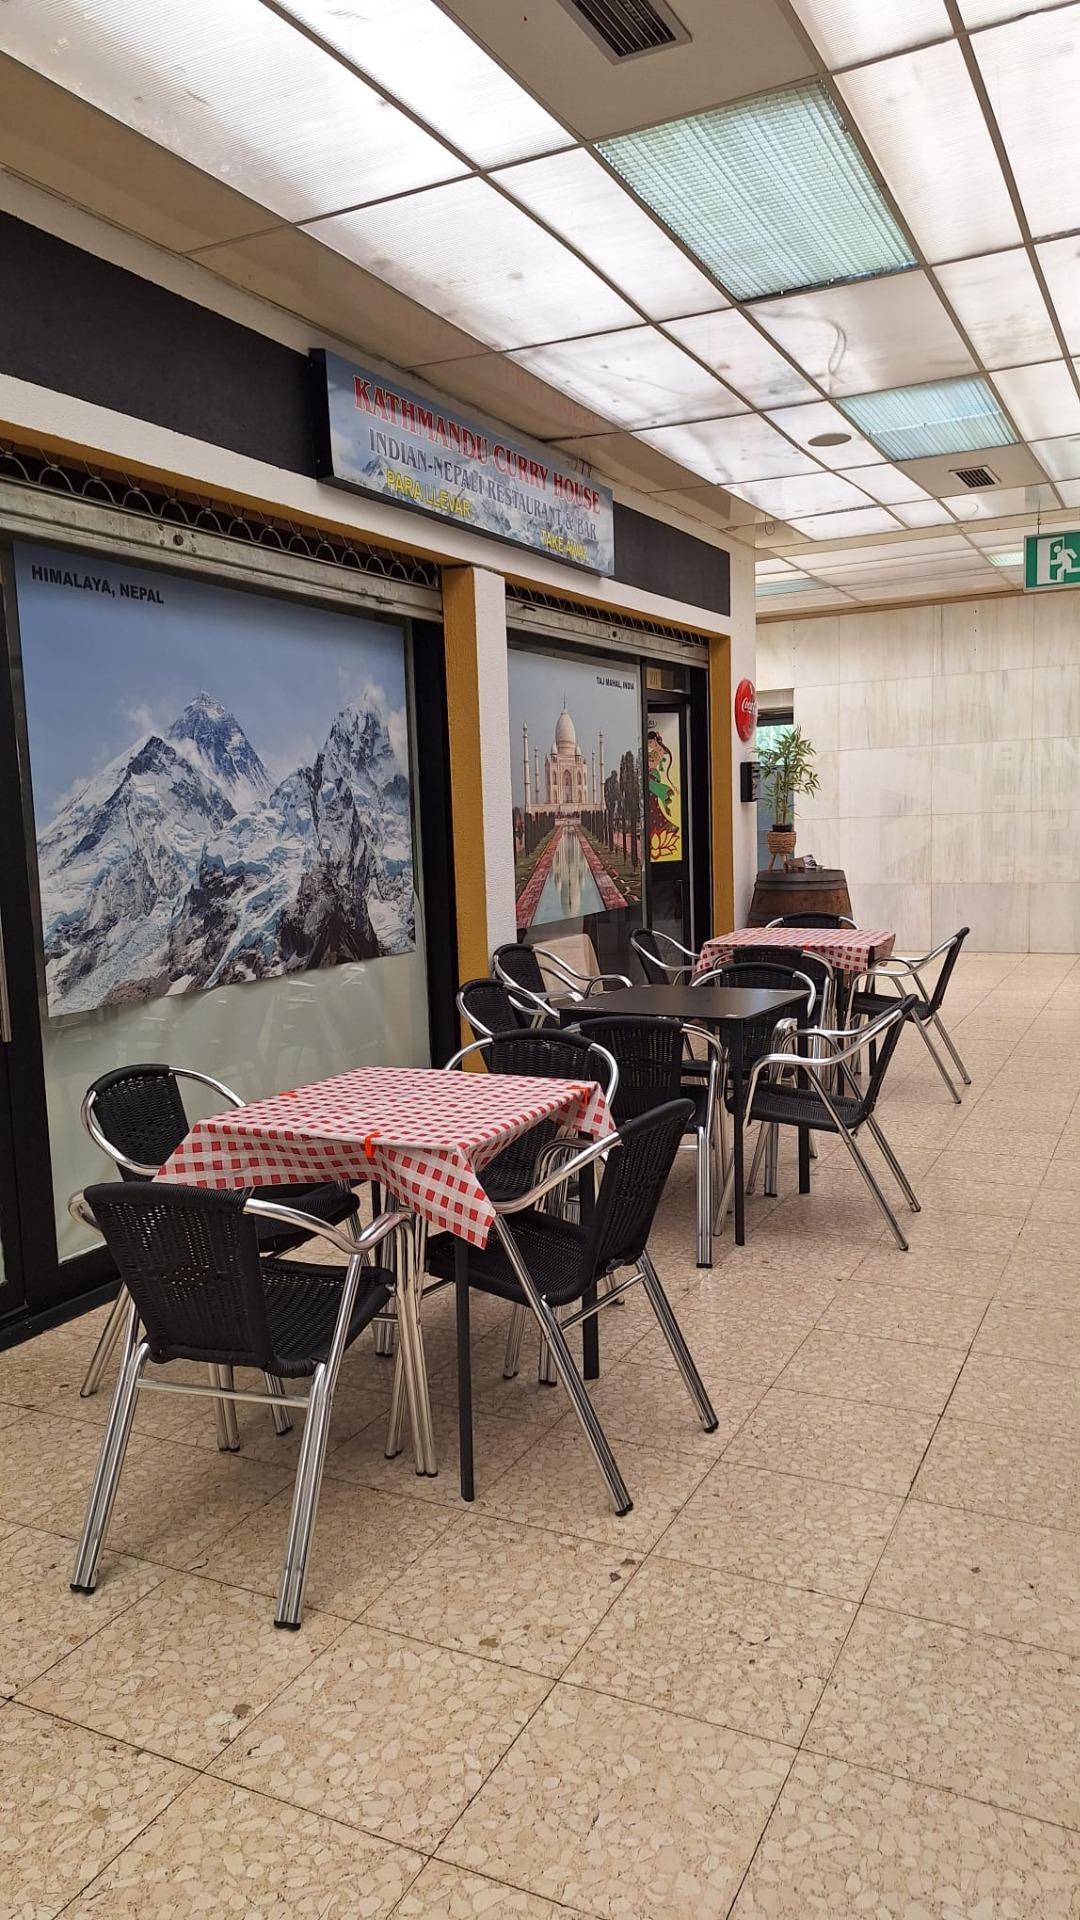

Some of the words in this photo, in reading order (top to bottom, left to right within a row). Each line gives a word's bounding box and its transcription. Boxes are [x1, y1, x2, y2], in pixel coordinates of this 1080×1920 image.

[354, 376, 488, 464] KATHMANDU
[493, 444, 549, 491] CURRY
[552, 471, 600, 515] HOUSE
[369, 429, 484, 495] INDIAN-NEPALI
[487, 479, 562, 526] RESTAURANT
[577, 518, 597, 540] BAR
[386, 469, 422, 500] PARA
[424, 483, 471, 517] LLEVAR
[31, 564, 116, 598] HIMALAYA,
[119, 582, 165, 604] NEPAL
[596, 676, 605, 686] TAJ
[622, 681, 635, 690] INDIA
